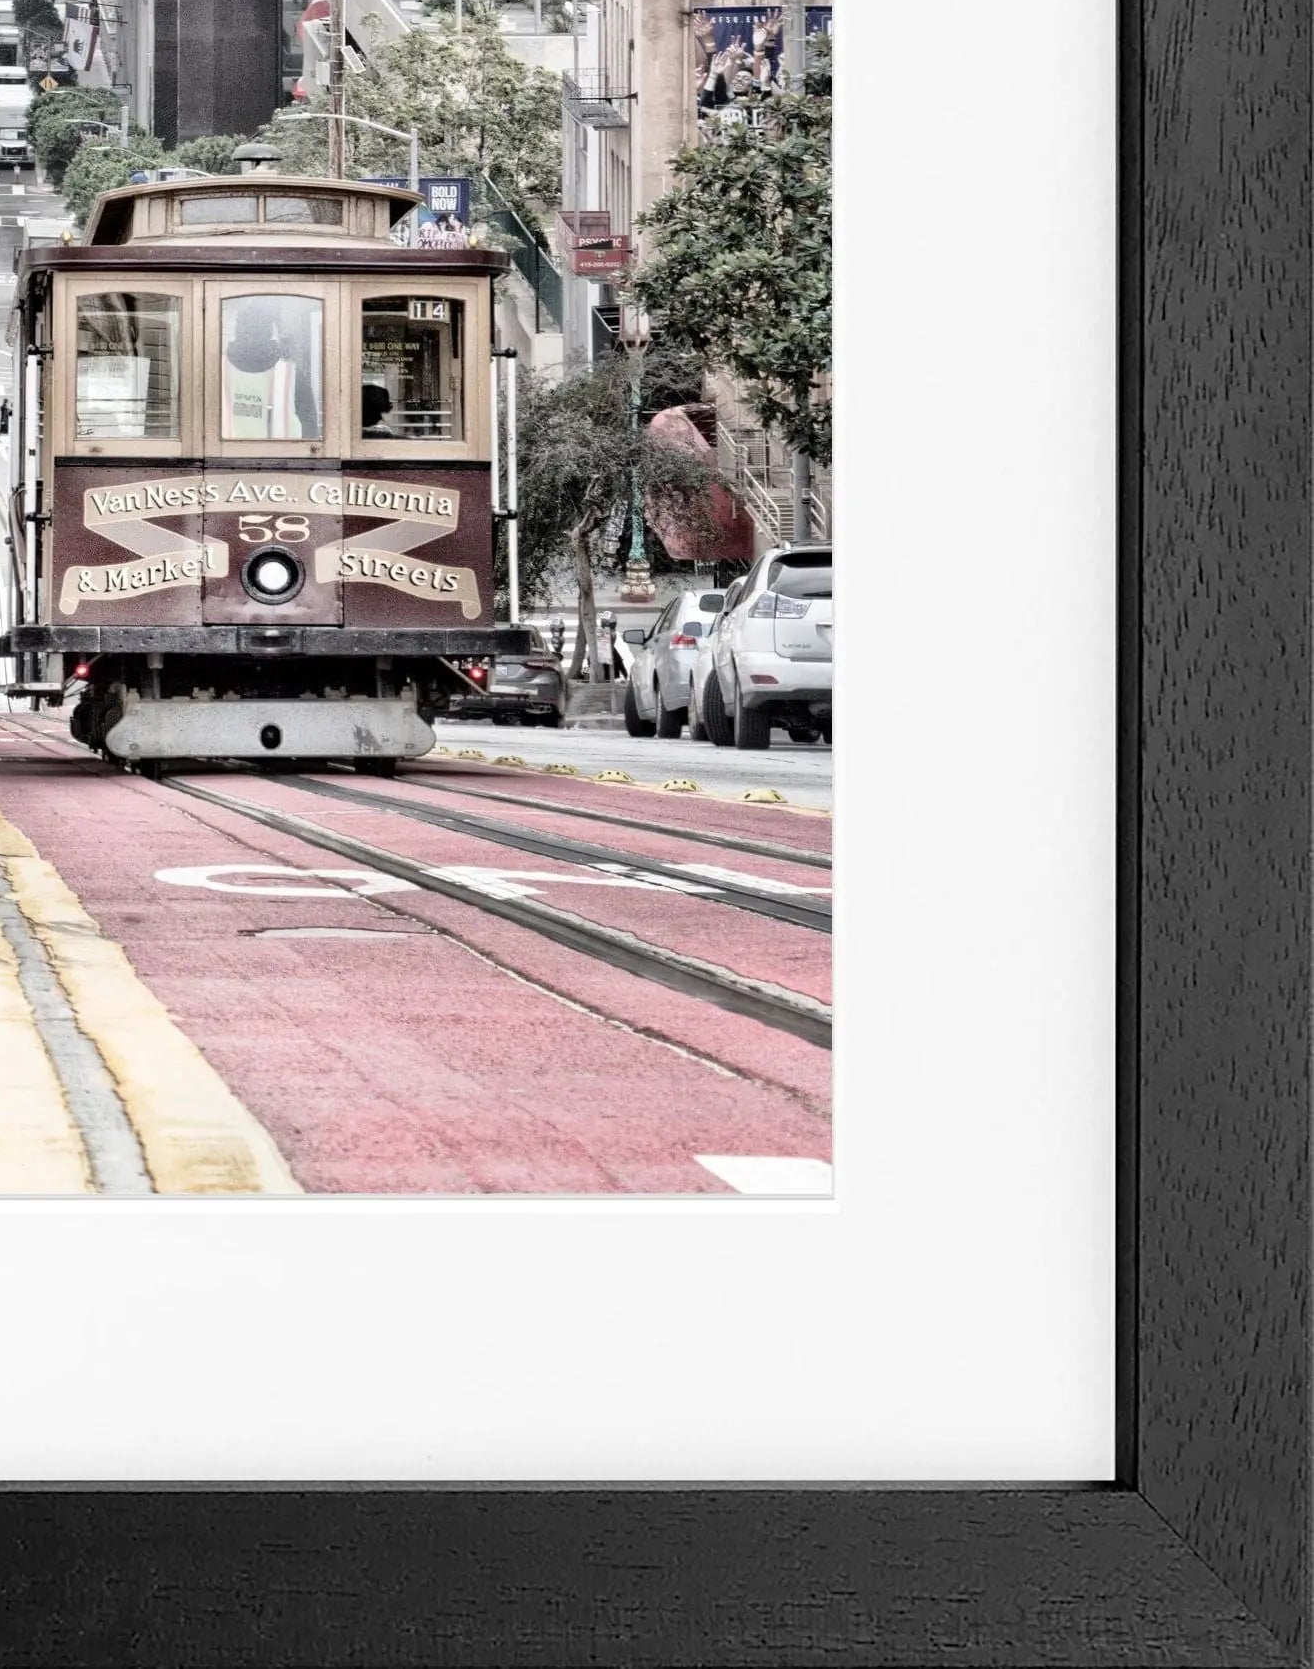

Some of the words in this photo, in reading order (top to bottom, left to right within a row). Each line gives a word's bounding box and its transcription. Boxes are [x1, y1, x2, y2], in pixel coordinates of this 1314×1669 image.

[431, 185, 458, 198] BOLD
[431, 198, 457, 211] NOW
[578, 237, 623, 247] PSYIC
[91, 491, 141, 515] Van
[143, 484, 220, 509] Ness
[309, 482, 453, 517] California
[238, 515, 311, 543] 58
[78, 569, 101, 593] &
[104, 547, 215, 593] Market
[339, 552, 461, 593] Streets
